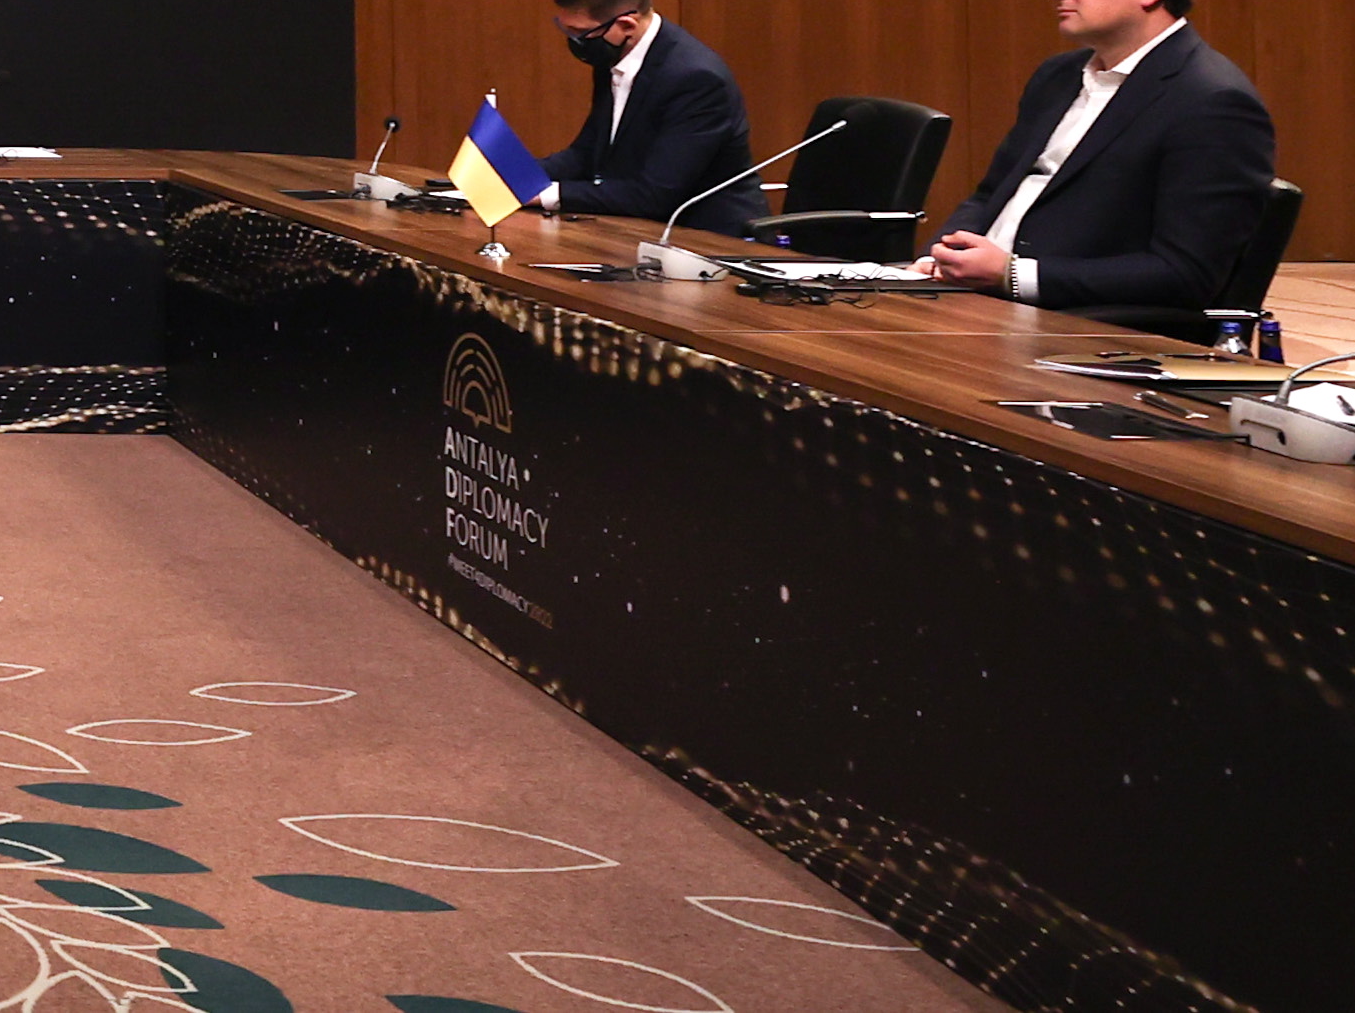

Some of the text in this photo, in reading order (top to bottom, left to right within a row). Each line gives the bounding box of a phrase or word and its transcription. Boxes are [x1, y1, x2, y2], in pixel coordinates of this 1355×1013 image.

[444, 426, 519, 491] ANTALYA
[445, 466, 549, 548] DIPLOMACY
[446, 507, 509, 571] FORUM
